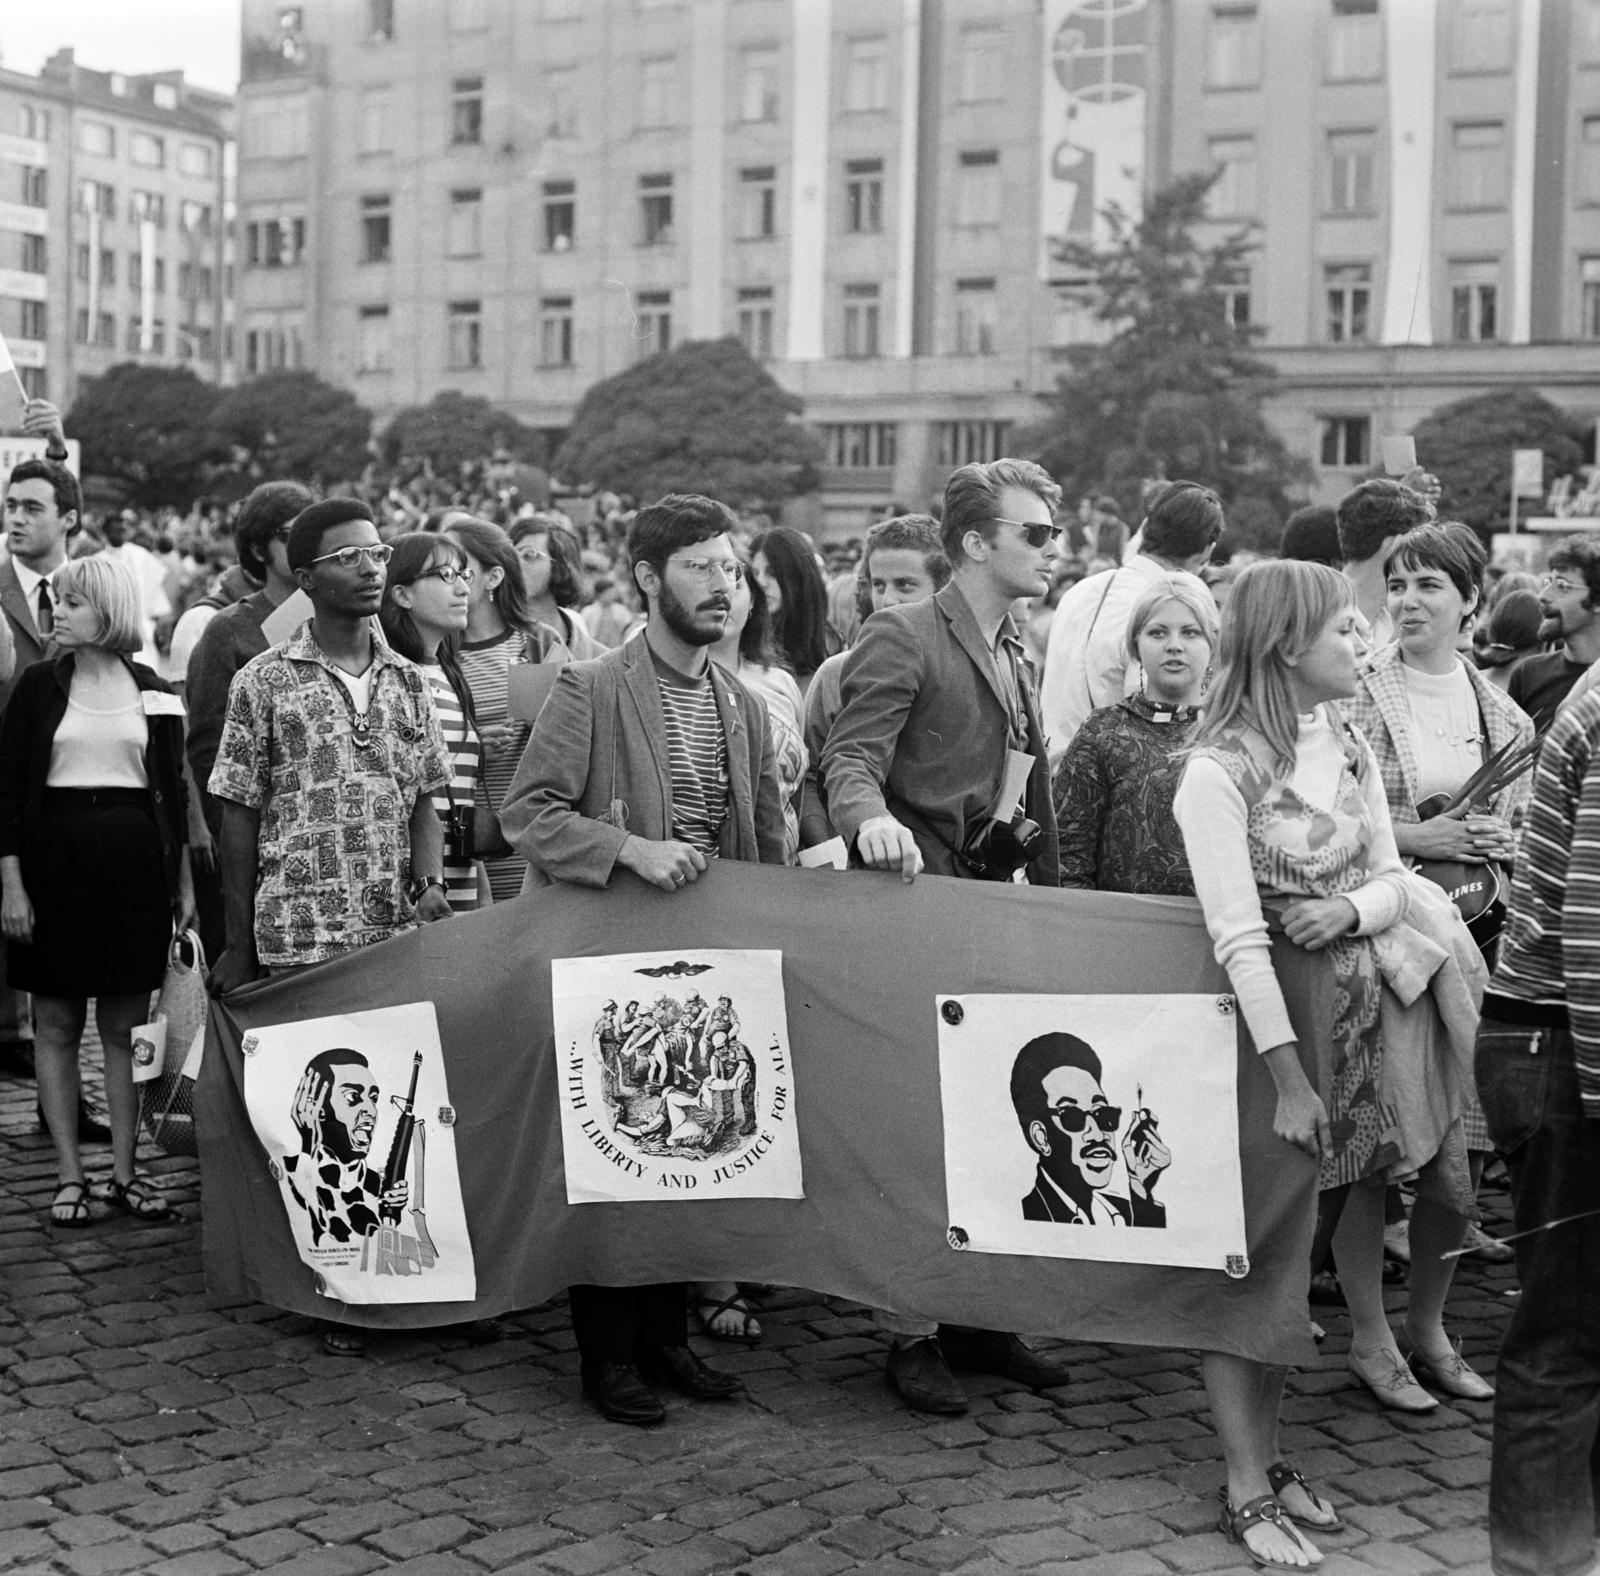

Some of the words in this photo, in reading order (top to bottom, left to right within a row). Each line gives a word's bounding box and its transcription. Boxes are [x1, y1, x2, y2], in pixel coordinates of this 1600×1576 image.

[581, 1119, 648, 1178] LIBERTY
[656, 1173, 697, 1189] AND
[713, 1130, 775, 1184] JUSTICE
[771, 1086, 787, 1121] FOR
